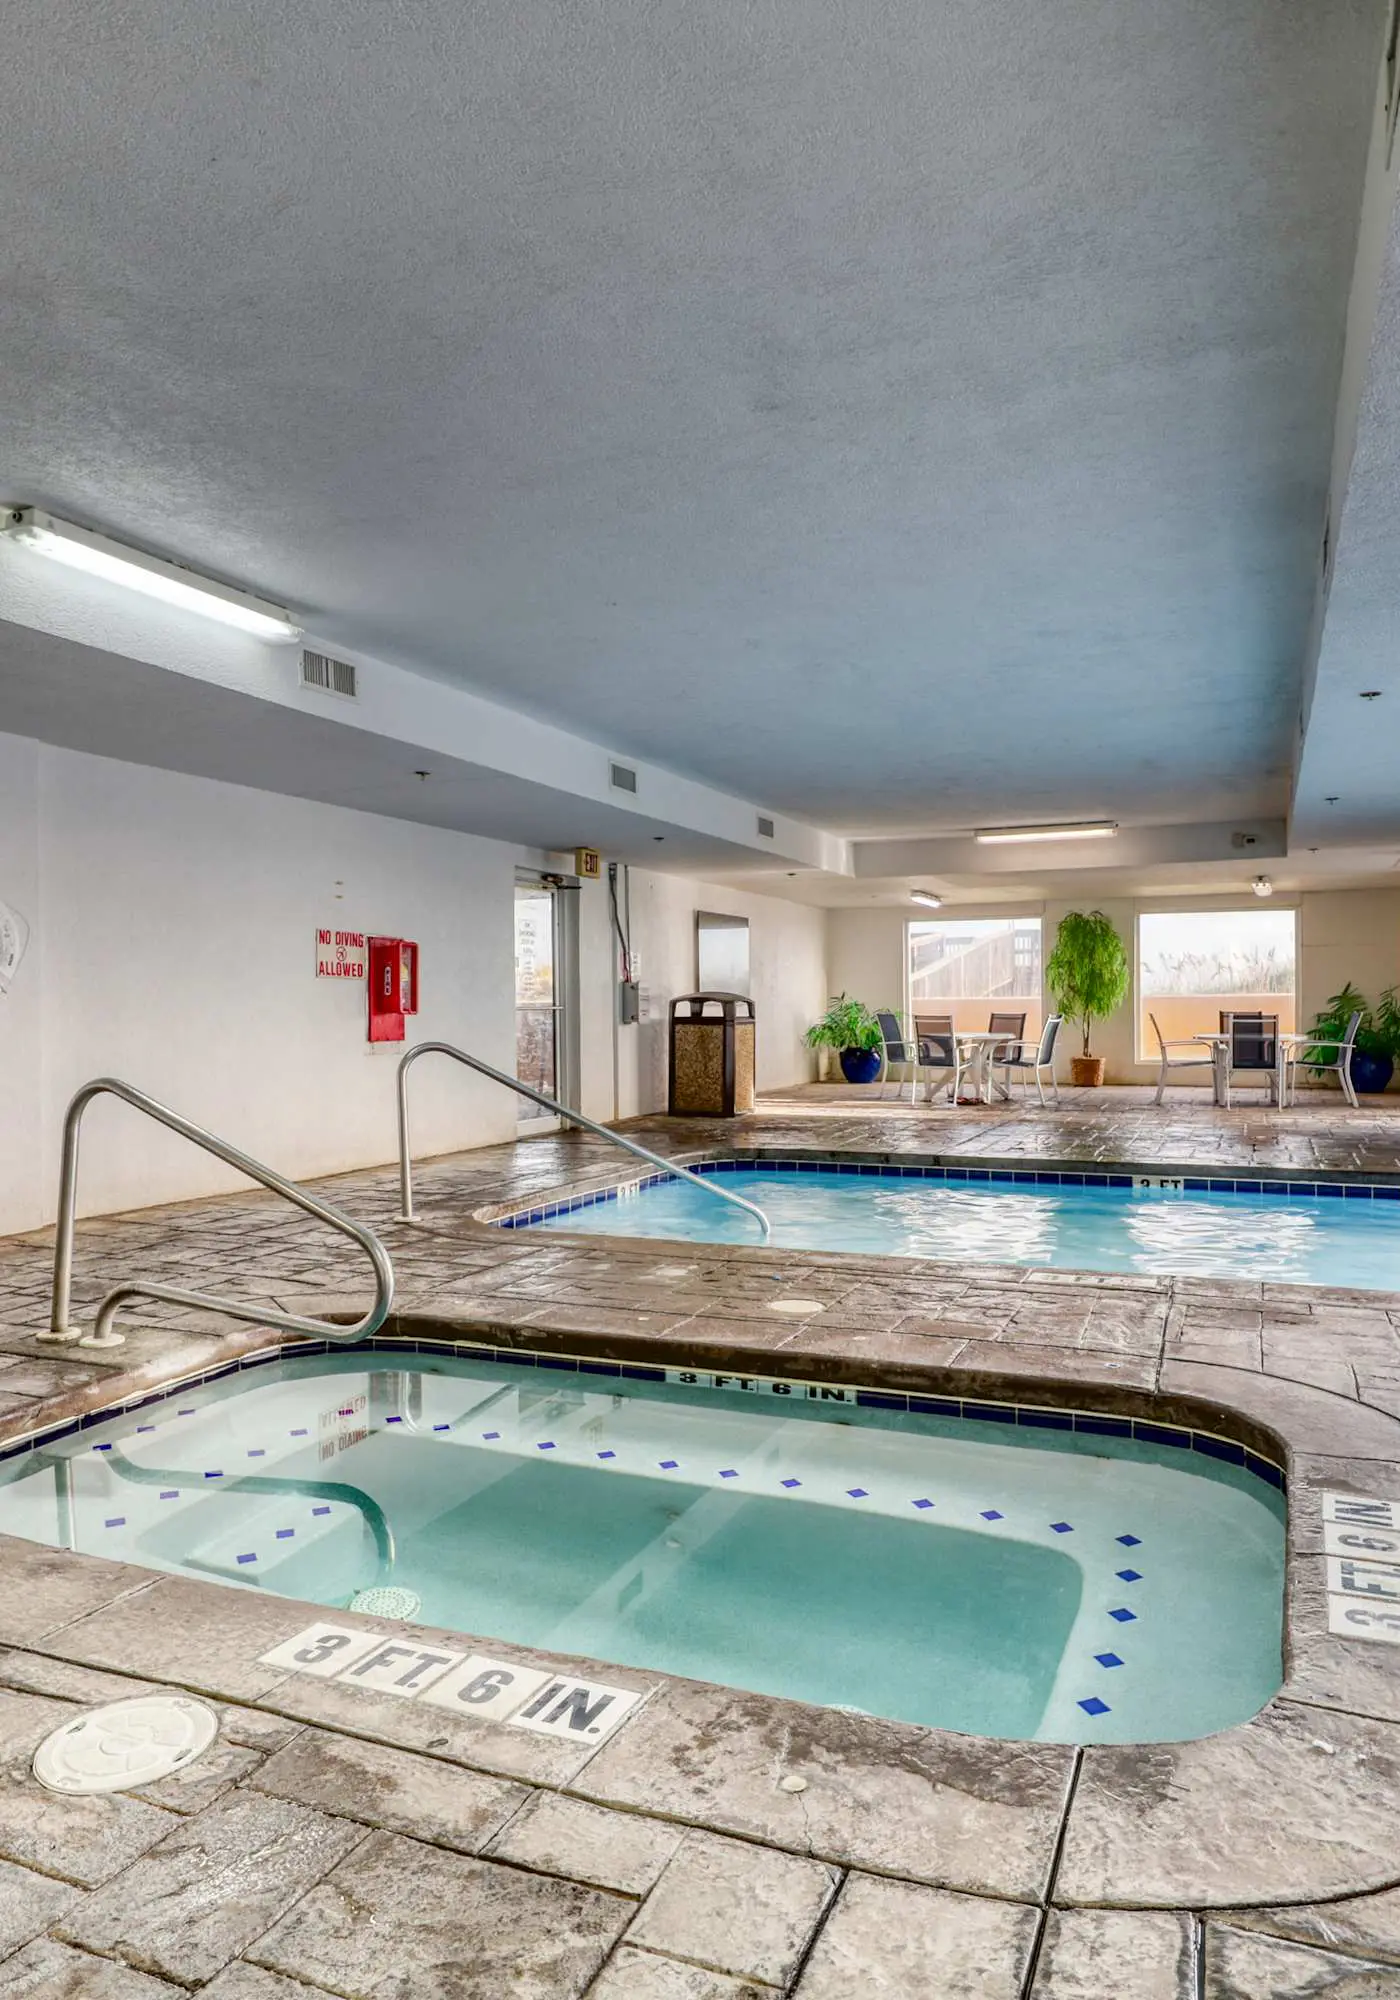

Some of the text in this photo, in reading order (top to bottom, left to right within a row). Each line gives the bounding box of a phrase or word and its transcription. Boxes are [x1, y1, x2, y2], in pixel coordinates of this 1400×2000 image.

[585, 852, 598, 872] EXIT
[319, 929, 364, 948] NO DIVING
[319, 961, 363, 977] ALLOWED
[679, 1372, 852, 1402] 3 FT. 6 IN.
[1335, 1500, 1393, 1527] IN.
[1338, 1534, 1398, 1552] 6
[294, 1634, 616, 1734] 3 FT. 6 IN.
